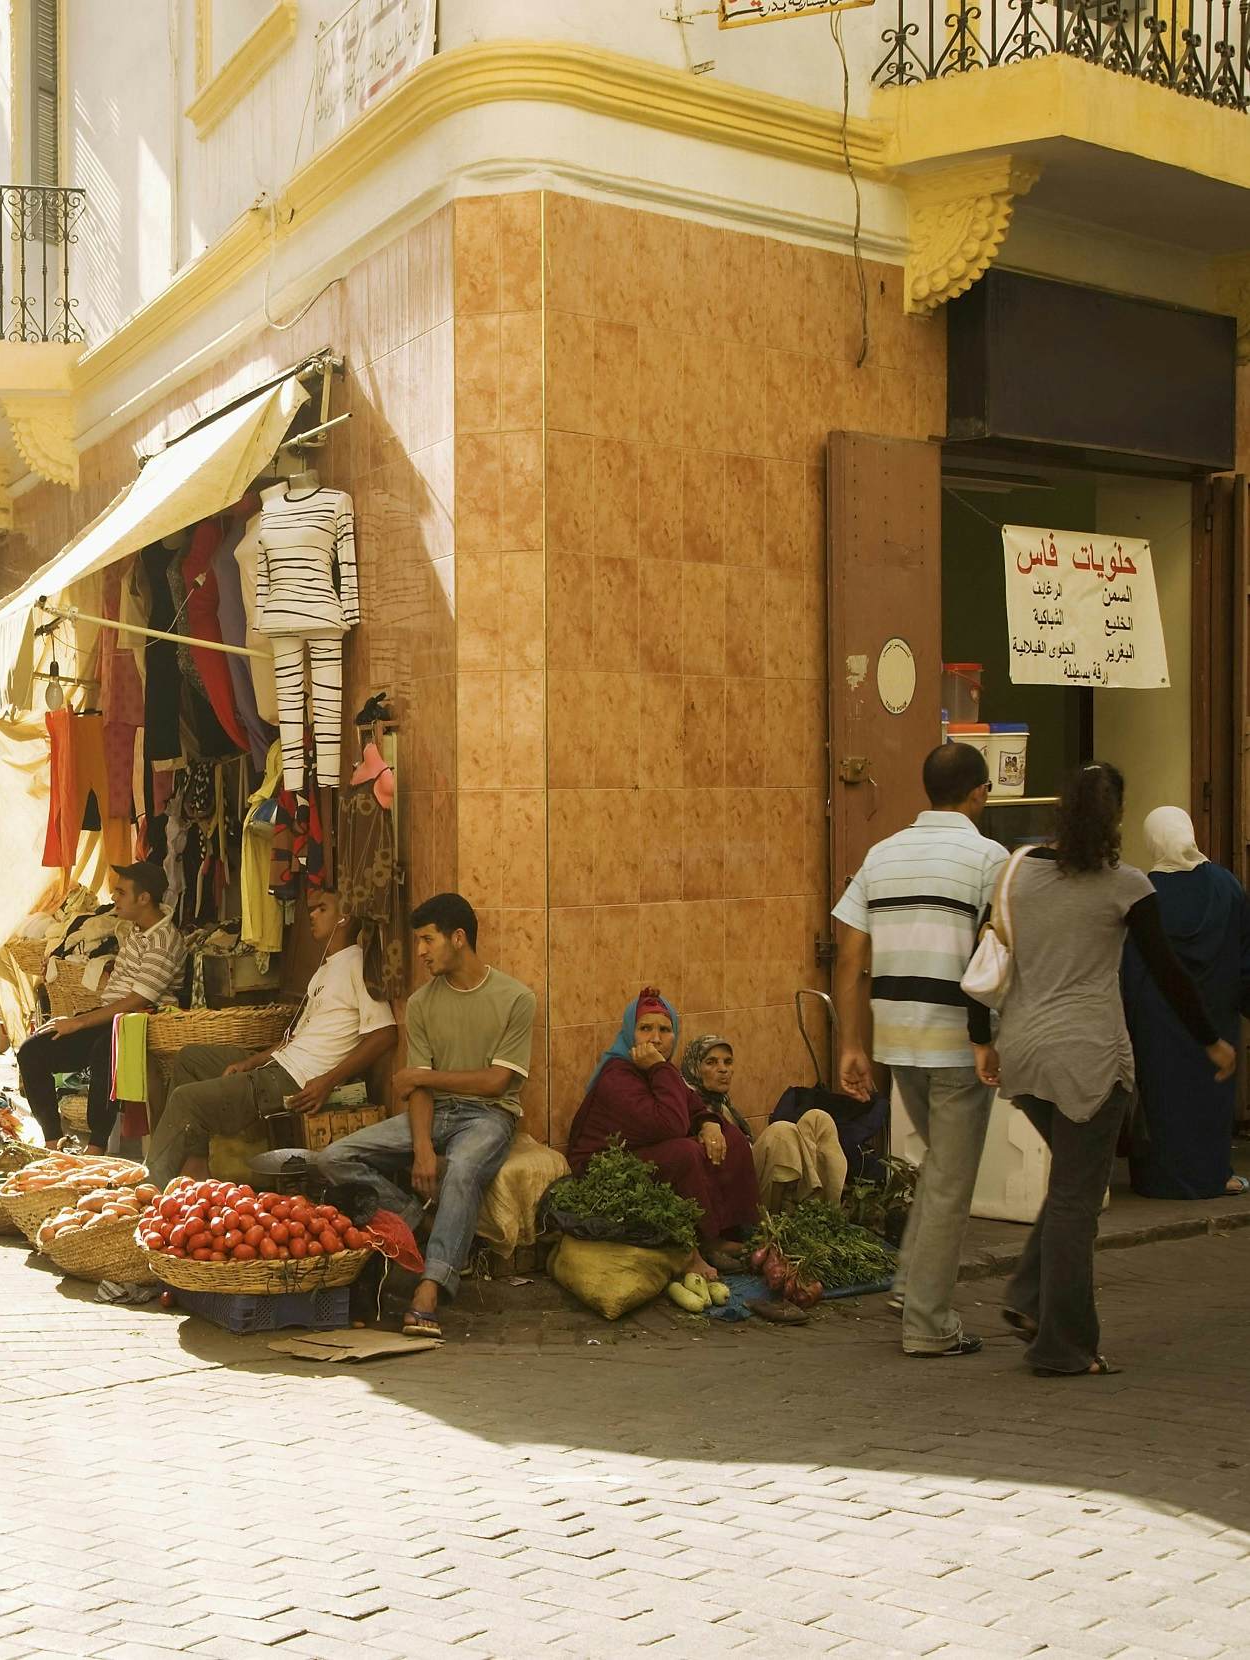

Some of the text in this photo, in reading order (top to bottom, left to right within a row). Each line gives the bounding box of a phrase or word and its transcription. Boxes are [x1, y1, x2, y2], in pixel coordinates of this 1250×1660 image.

[1016, 532, 1138, 582] حلويات فاس
[1102, 585, 1133, 607] السمن
[1033, 608, 1065, 630] الشباكية
[1104, 615, 1134, 637] الخليع
[1049, 641, 1076, 659] الحلوى
[1105, 642, 1135, 664] البغرير
